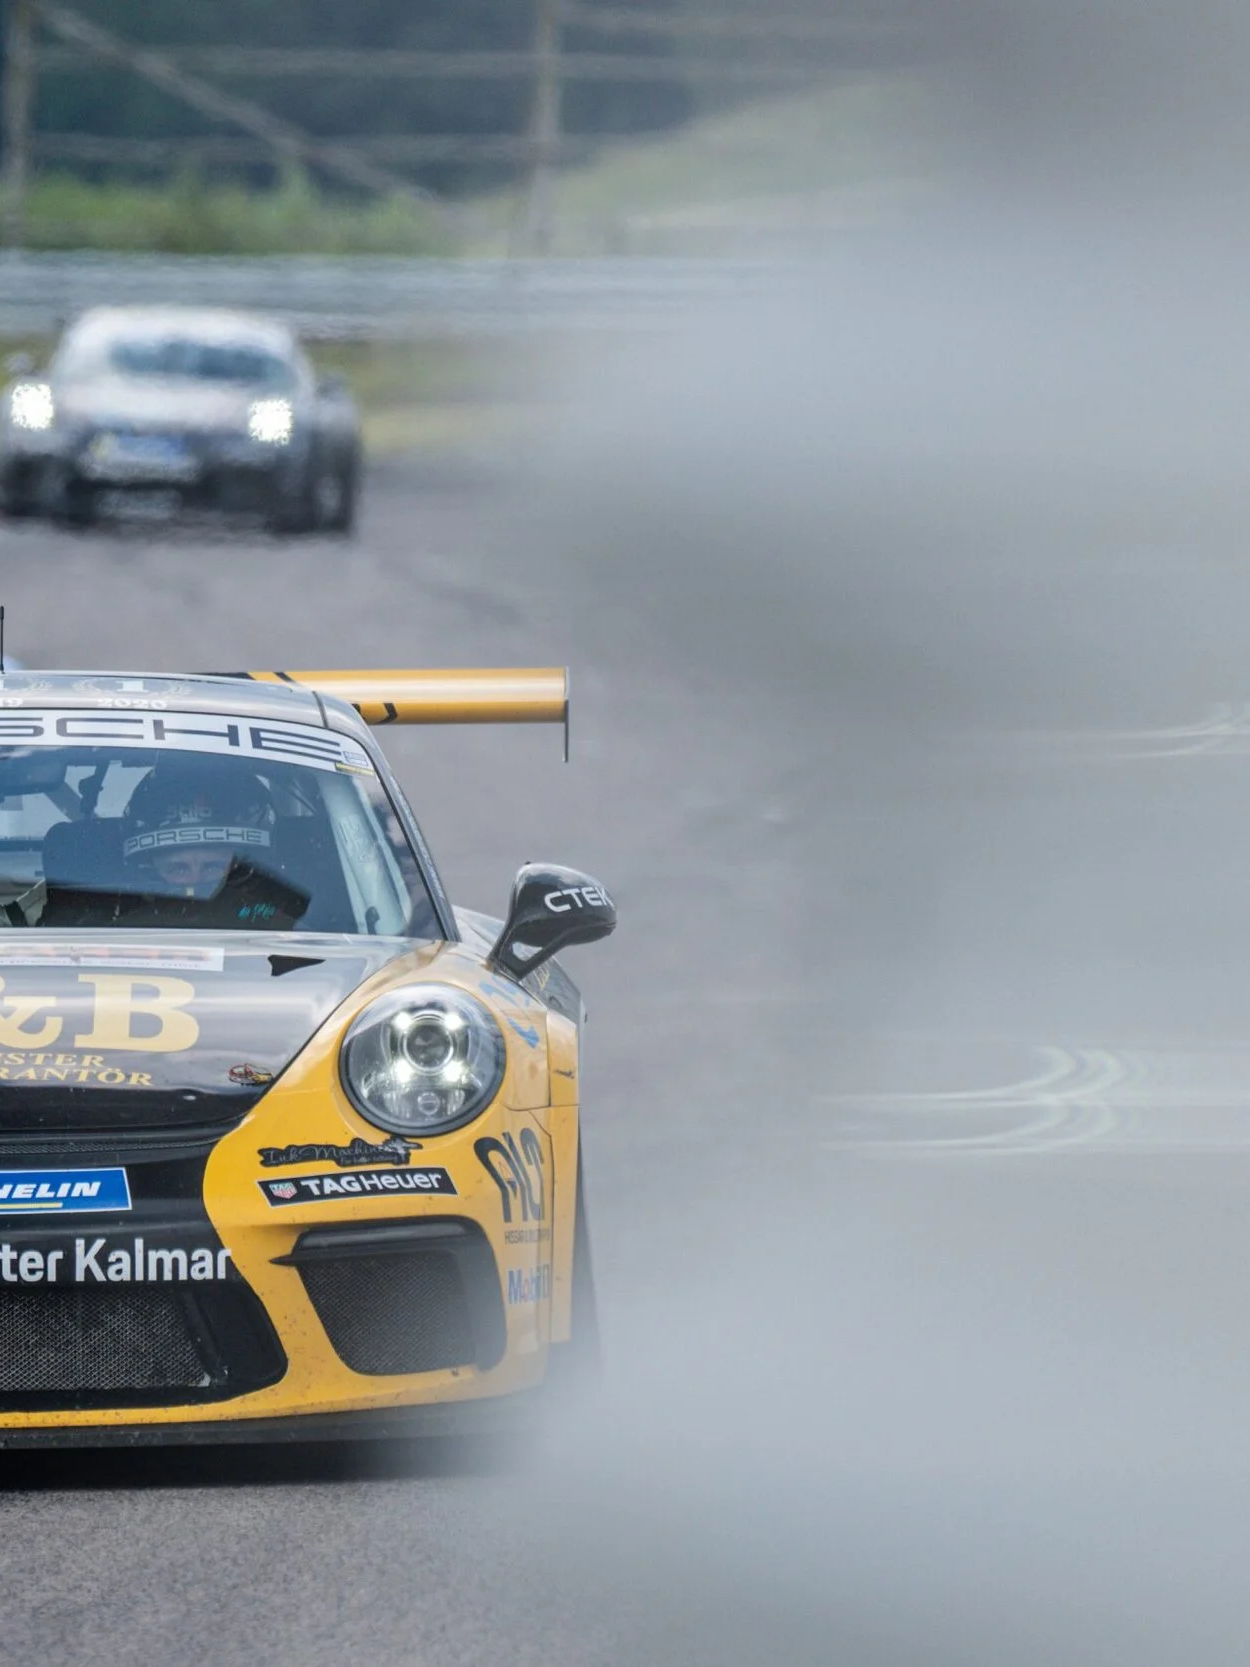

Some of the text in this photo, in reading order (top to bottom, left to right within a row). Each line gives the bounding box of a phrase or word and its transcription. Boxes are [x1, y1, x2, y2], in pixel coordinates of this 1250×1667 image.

[97, 698, 169, 710] 2020
[127, 828, 262, 850] PORSCHE
[544, 886, 615, 913] CTEK
[75, 1237, 232, 1283] Kalmar
